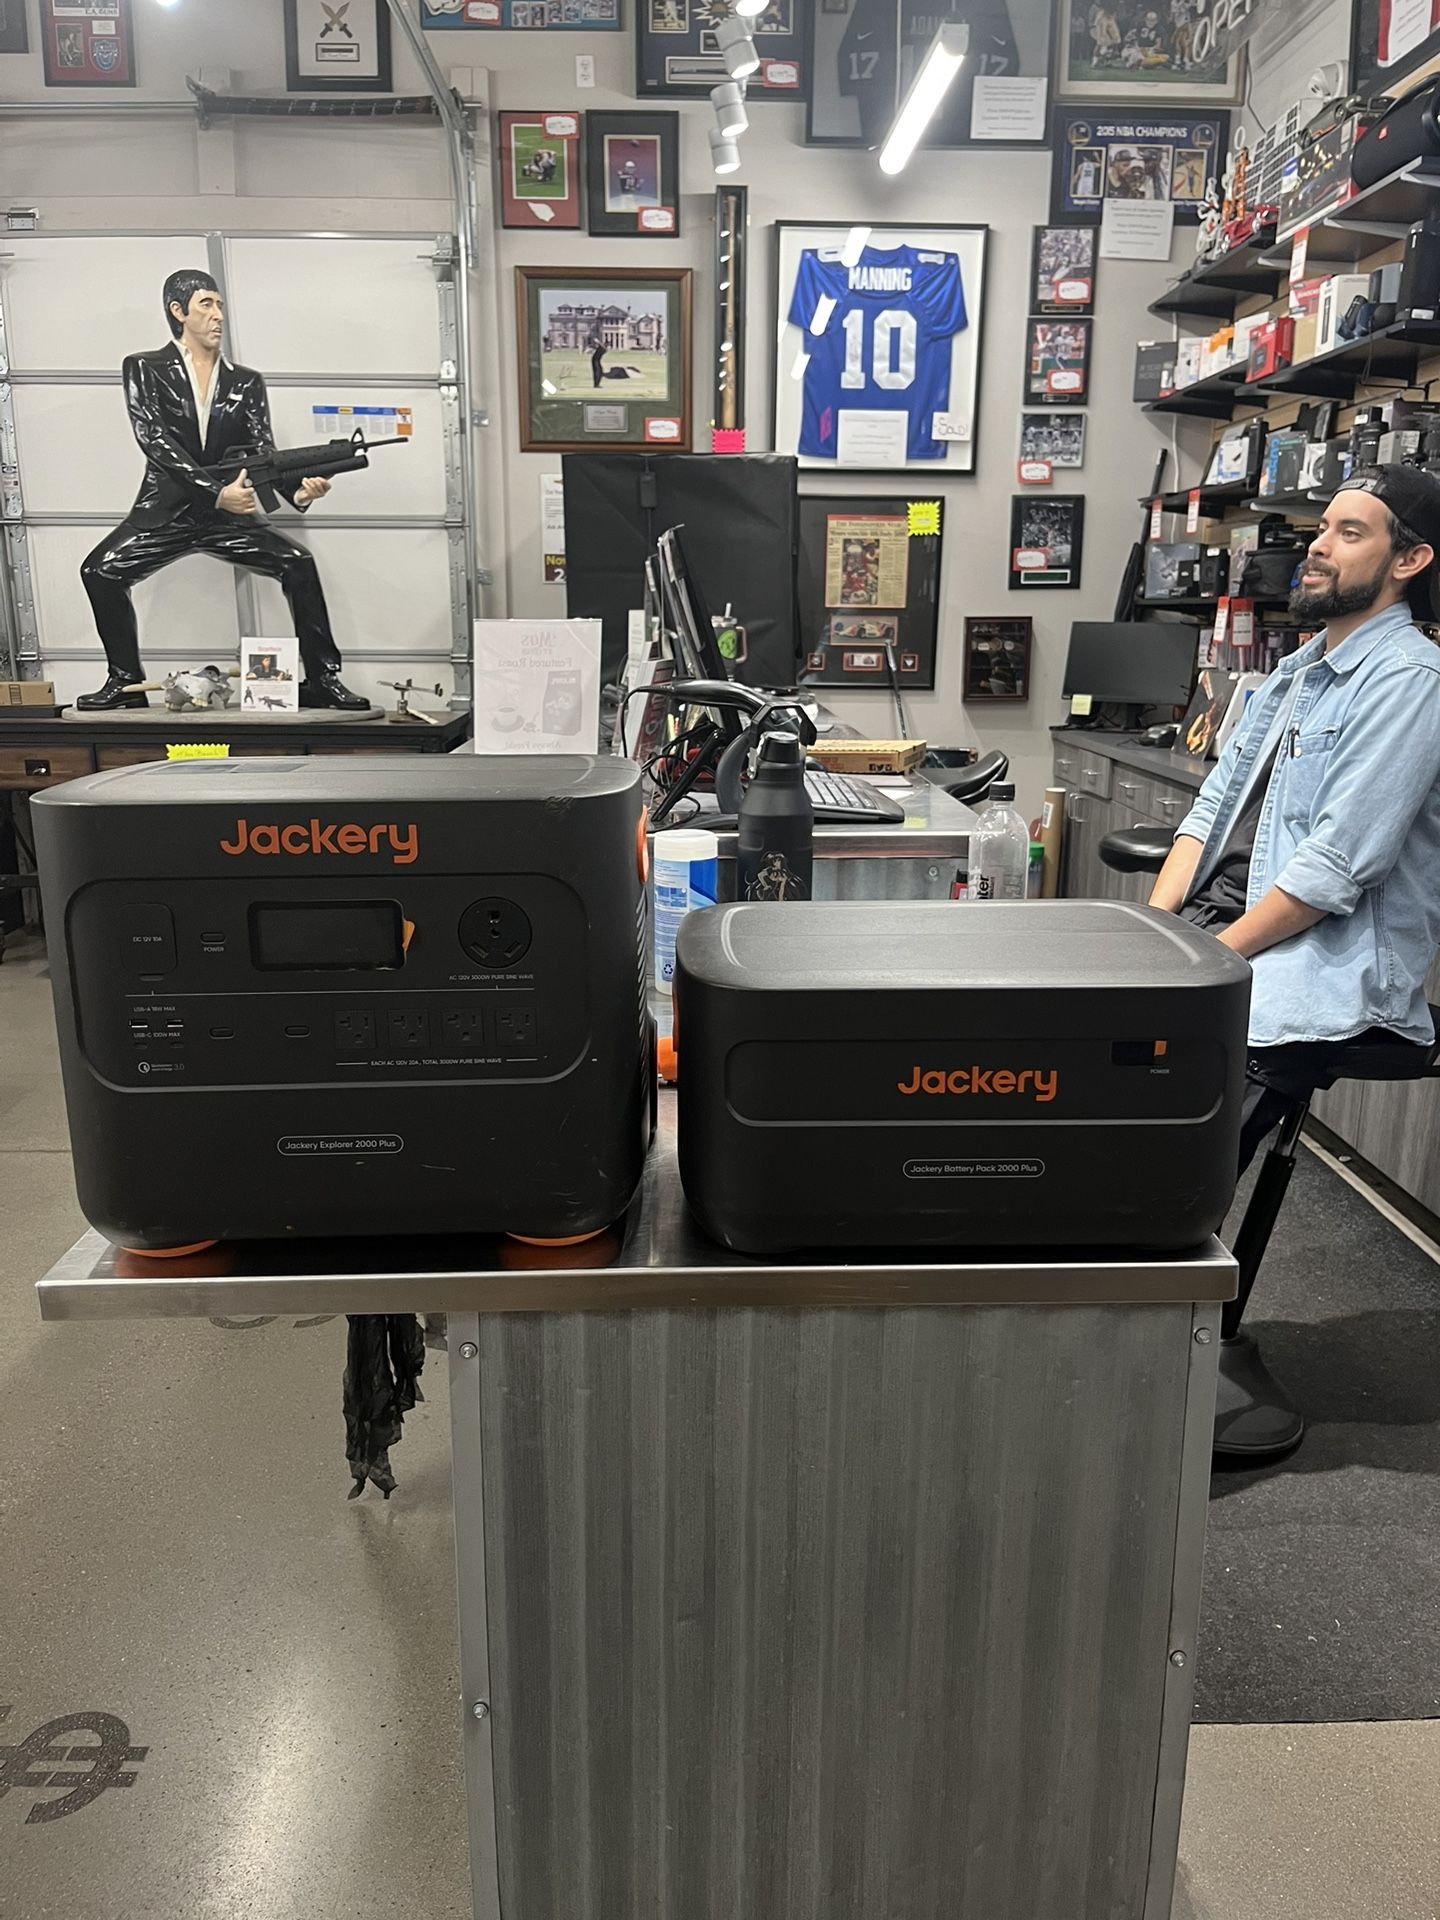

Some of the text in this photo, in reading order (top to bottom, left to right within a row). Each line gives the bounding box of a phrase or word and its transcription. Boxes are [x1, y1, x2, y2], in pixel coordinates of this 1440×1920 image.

[850, 52, 878, 80] 17
[1116, 126, 1135, 136] NBA
[1135, 127, 1188, 138] CHAMPIONS
[848, 266, 913, 291] MANNING
[840, 309, 918, 390] 10
[220, 818, 419, 864] Jackery
[897, 1066, 1057, 1101] Jackery
[285, 1142, 318, 1151] Jackery
[320, 1141, 353, 1149] Explorer
[355, 1140, 377, 1148] 2000
[911, 1164, 1038, 1174] Jackery Battery Pack 2000 Plus
